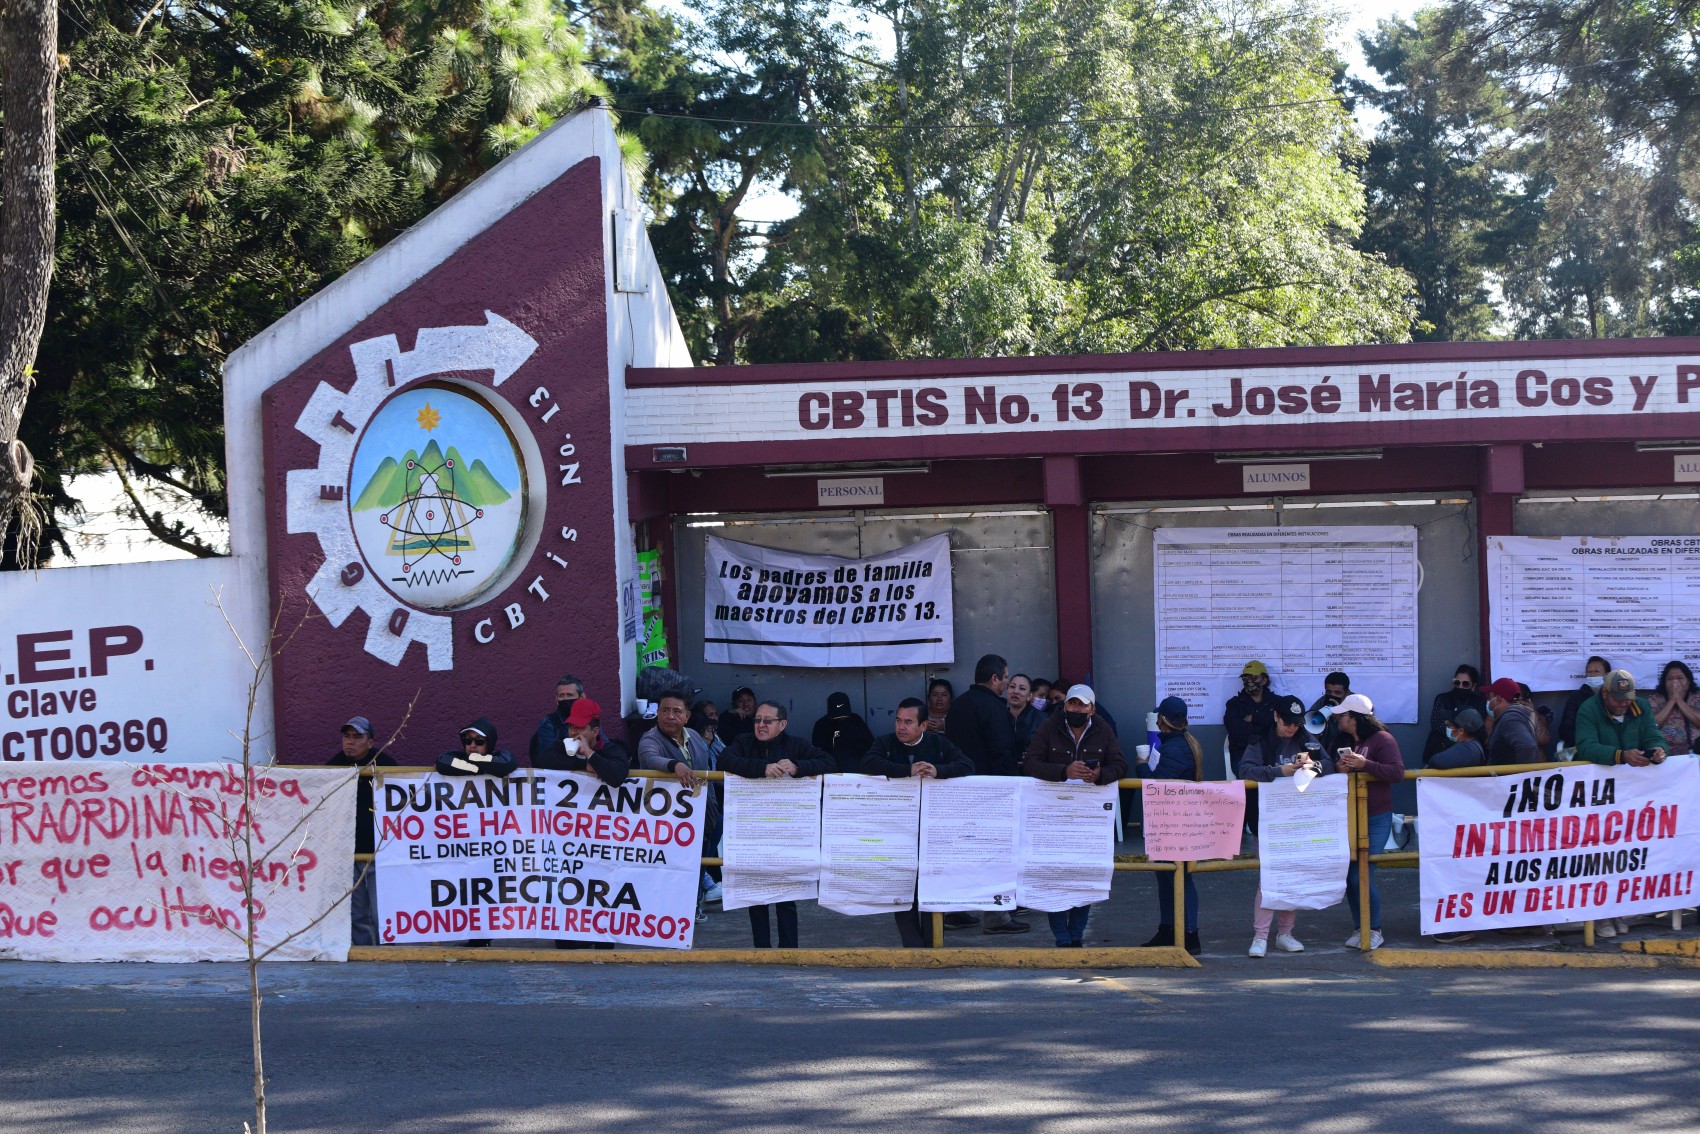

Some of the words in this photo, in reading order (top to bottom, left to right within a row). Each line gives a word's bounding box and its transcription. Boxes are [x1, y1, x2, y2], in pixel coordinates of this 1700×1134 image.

[798, 387, 949, 430] CBTIS
[964, 385, 1039, 426] No.
[1051, 382, 1104, 422] 13
[1129, 381, 1196, 420] Dr.
[1212, 375, 1342, 418] José
[1358, 371, 1500, 413] María
[1514, 369, 1614, 407] Cos
[1629, 375, 1659, 411] y
[1676, 364, 1700, 404] P
[819, 485, 884, 498] PERSONAL
[1246, 472, 1307, 484] ALUMNOS
[719, 560, 753, 580] Los
[758, 568, 828, 587] padres
[833, 564, 857, 583] de
[863, 560, 933, 583] familia
[714, 603, 807, 625] maestros
[813, 606, 845, 625] del
[851, 604, 908, 624] CBTIS
[914, 601, 941, 621] 13.
[736, 582, 863, 606] apoyamos
[869, 587, 880, 602] a
[885, 584, 915, 601] los
[0, 625, 155, 686] .E.P.
[7, 687, 97, 719] Clave
[132, 764, 309, 805] asamblea
[385, 777, 546, 813] DURANTE
[555, 779, 579, 809] 2
[588, 777, 694, 819] AÑOS
[1146, 784, 1159, 796] Si
[1503, 773, 1564, 818] ¡NO
[1570, 780, 1585, 808] A
[1591, 777, 1615, 806] LA
[382, 814, 424, 841] NO
[434, 813, 470, 839] SE
[480, 809, 521, 837] HA
[531, 809, 696, 847] INGRESADO
[1452, 800, 1678, 859] INTIMIDACIÓN
[41, 852, 111, 894] que
[131, 841, 168, 880] la
[182, 847, 319, 893] niegan?
[409, 844, 431, 860] EL
[437, 840, 507, 859] DINERO
[513, 839, 536, 855] DE
[541, 839, 556, 856] LA
[562, 841, 667, 865] CAFETERIA
[493, 857, 516, 874] EN
[522, 857, 540, 873] EL
[543, 857, 584, 875] CEAP
[1485, 862, 1499, 886] A
[1504, 858, 1542, 884] LOS
[1545, 847, 1648, 880] ALUMNOS!
[430, 875, 642, 911] DIRECTORA
[1434, 892, 1473, 922] ¡ES
[1482, 890, 1516, 917] UN
[1524, 881, 1608, 913] DELITO
[1615, 871, 1694, 904] PENAL!
[382, 907, 480, 944] ¿DONDE
[488, 906, 537, 931] ESTA
[541, 906, 560, 931] EL
[565, 909, 691, 941] RECURSO?
